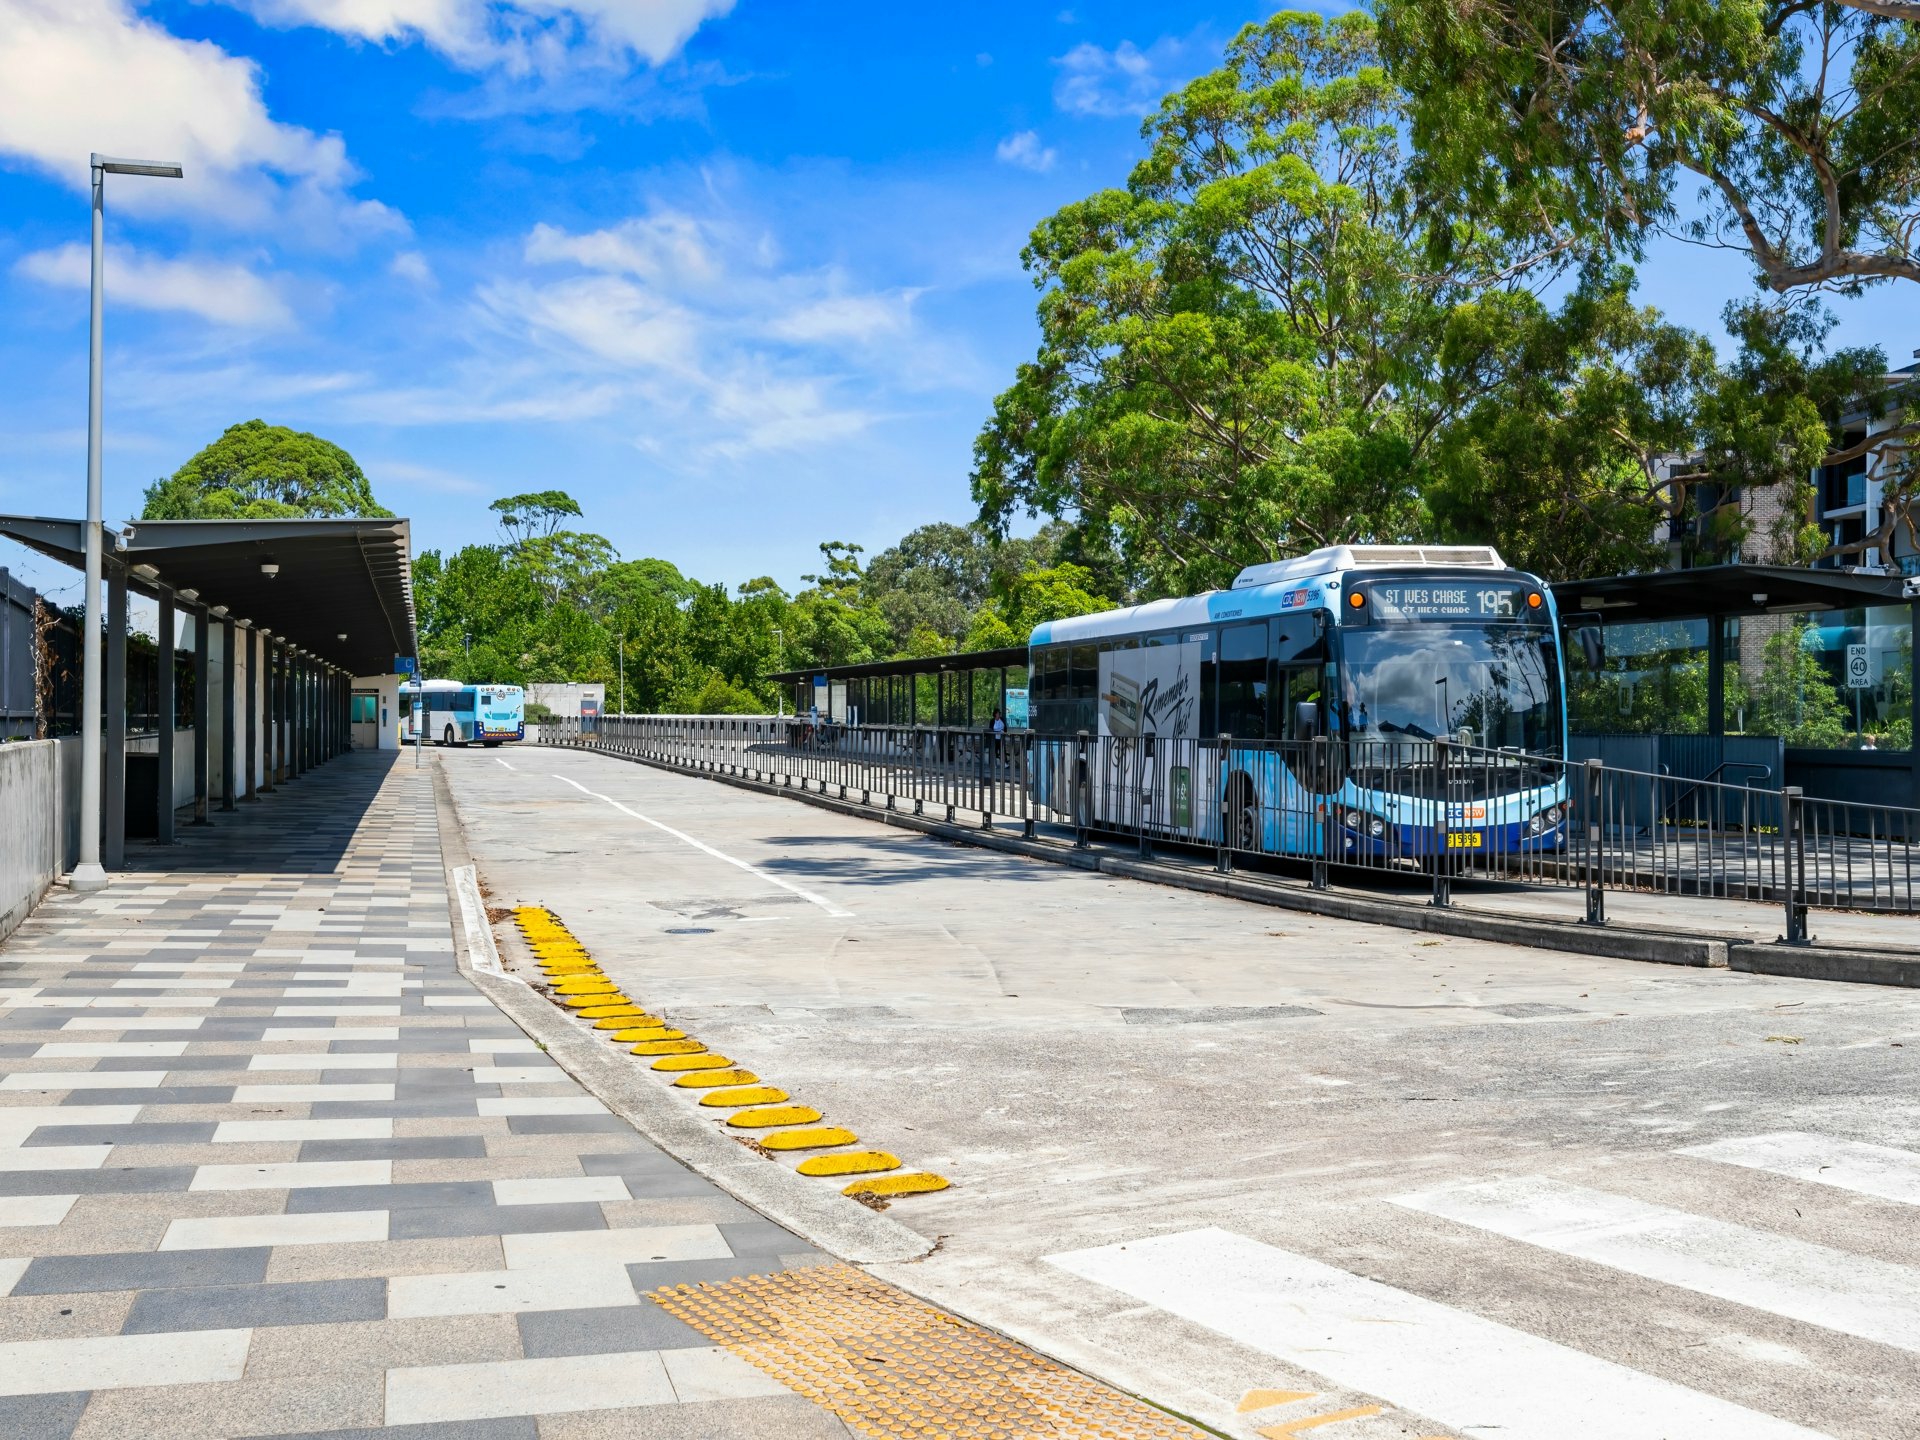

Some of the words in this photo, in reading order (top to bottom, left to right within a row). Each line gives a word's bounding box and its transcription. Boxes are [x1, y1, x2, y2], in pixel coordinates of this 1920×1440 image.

[1307, 589, 1320, 601] 5396
[1386, 589, 1399, 604] ST
[1404, 589, 1429, 604] IVES
[1432, 589, 1468, 604] CHASE
[1476, 590, 1513, 615] 195
[1851, 647, 1867, 655] END
[405, 659, 412, 668] C
[1853, 662, 1865, 671] 40
[1457, 834, 1478, 845] 5396
